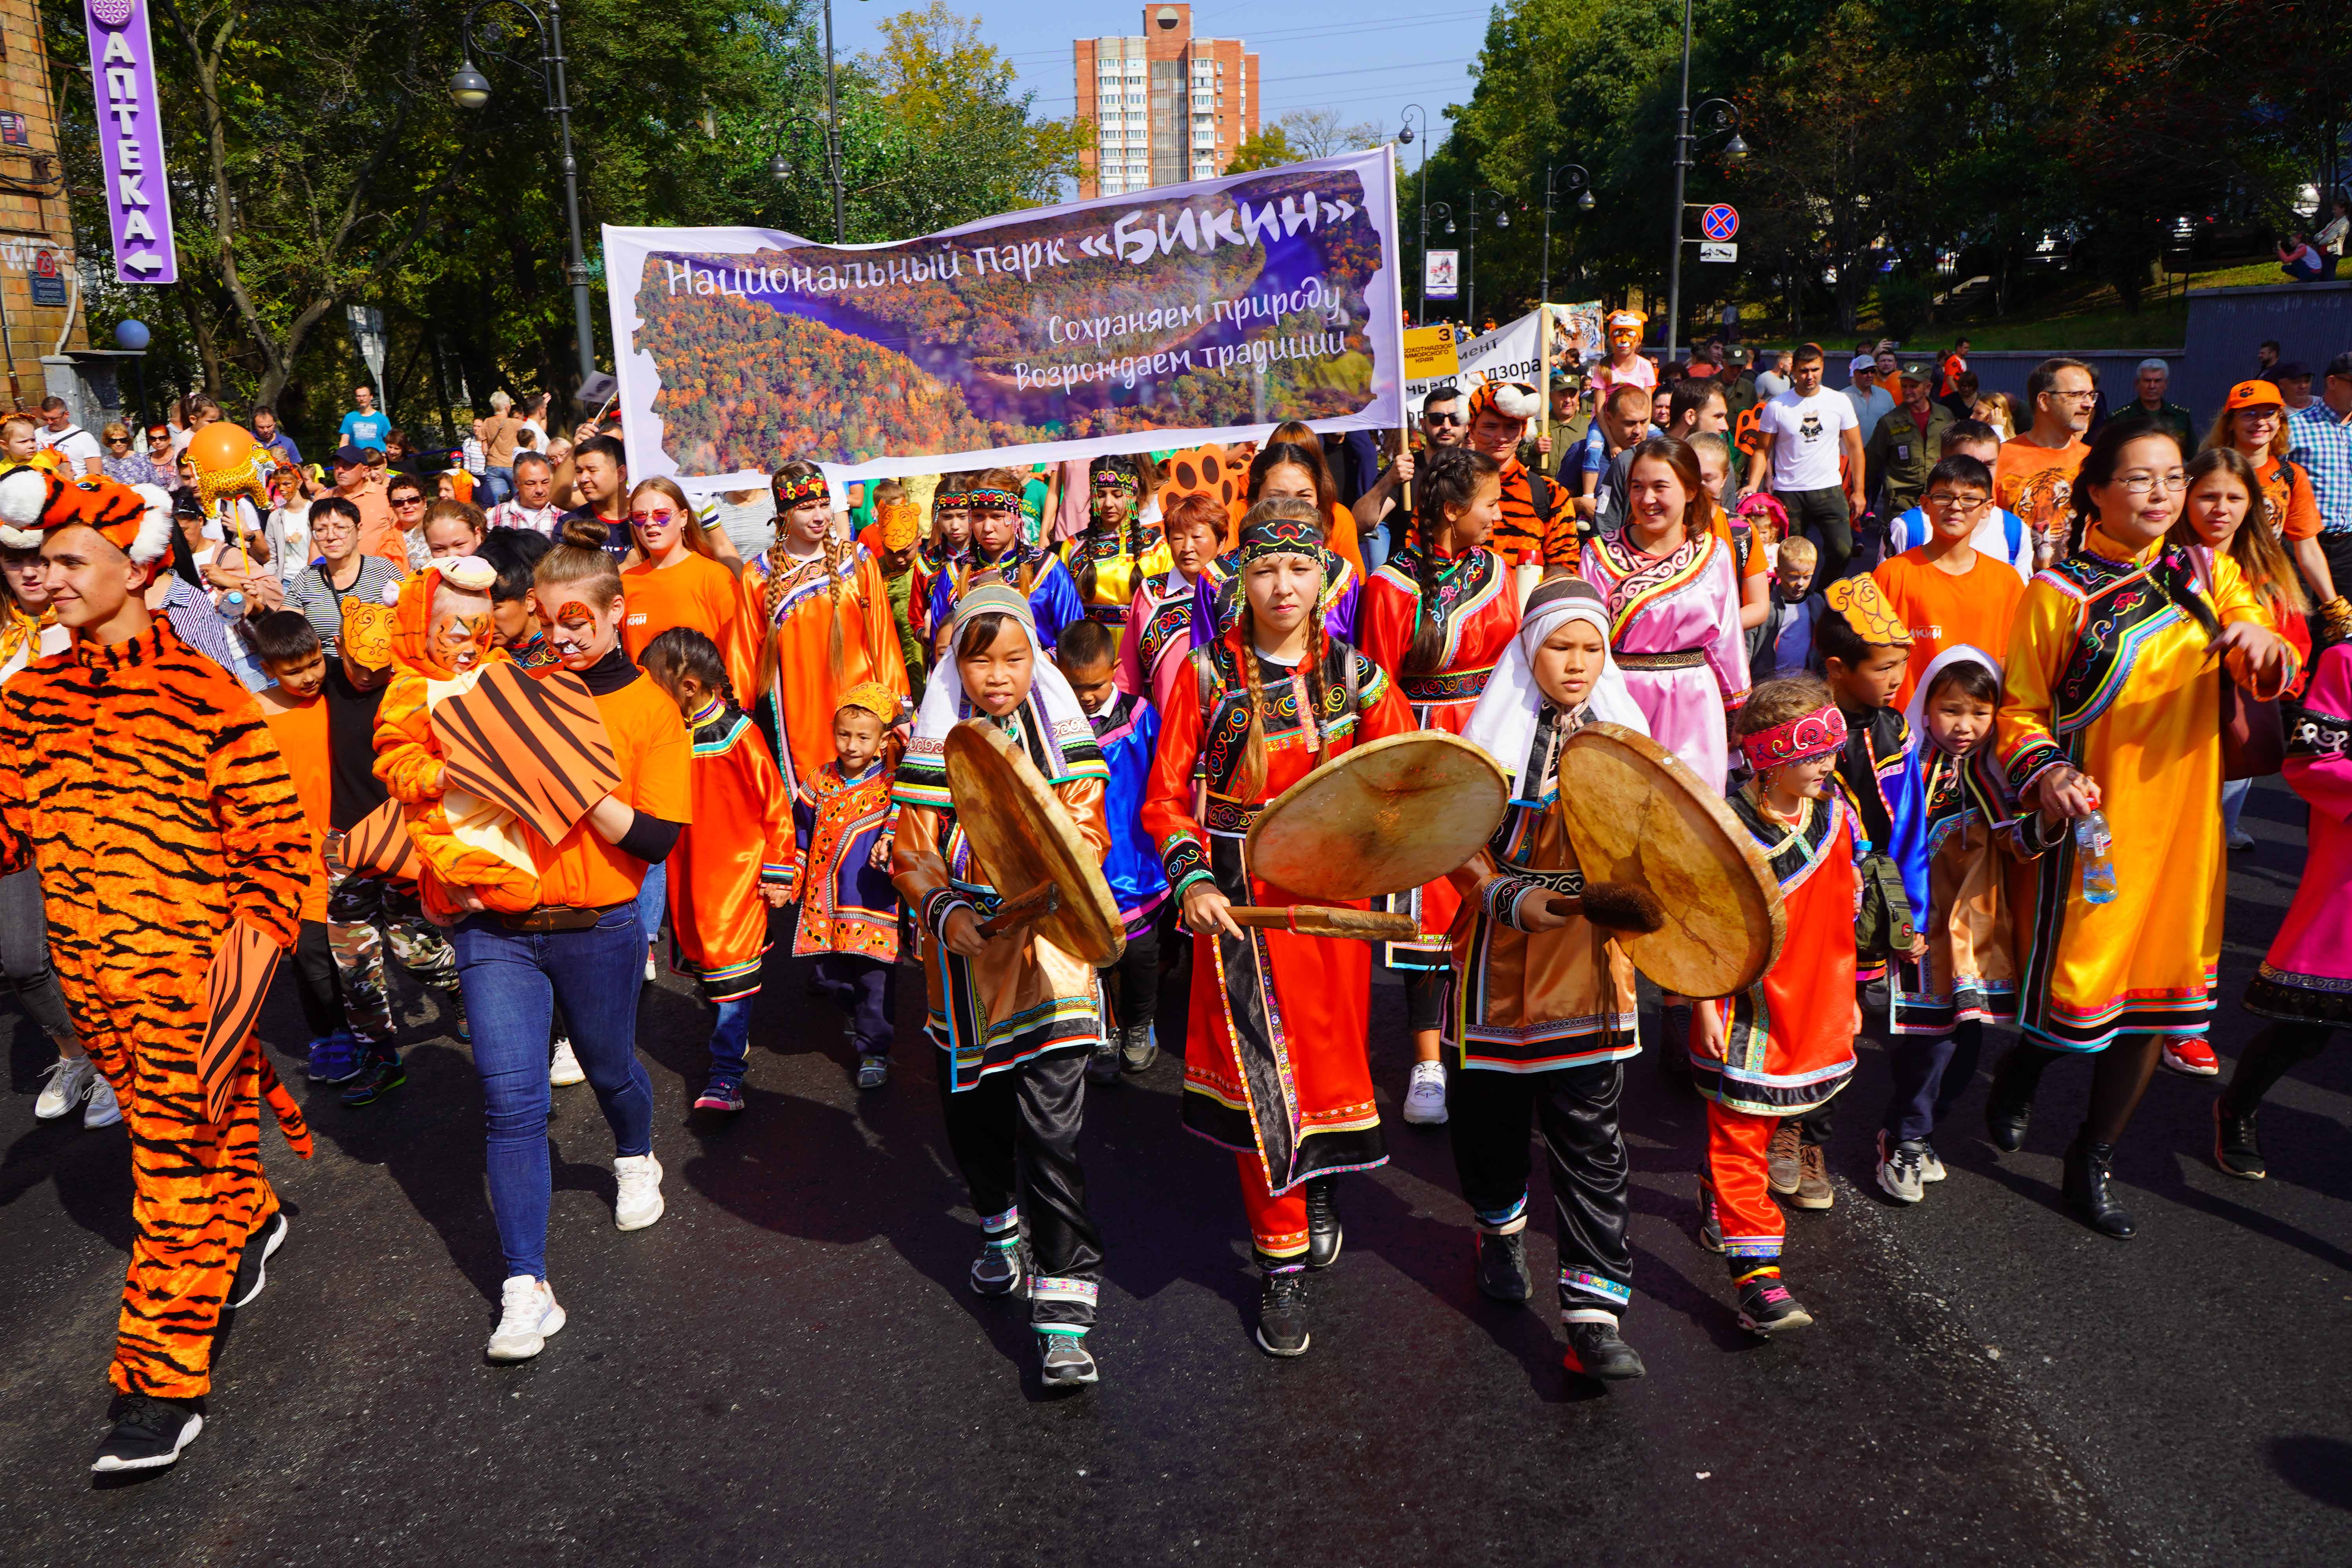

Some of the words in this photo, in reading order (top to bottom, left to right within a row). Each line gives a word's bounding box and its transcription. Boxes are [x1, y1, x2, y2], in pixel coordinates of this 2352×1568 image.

[102, 32, 156, 240] АПТЕКА
[39, 255, 53, 273] 29
[664, 241, 964, 299] Национальный
[973, 237, 1070, 283] парк
[1048, 303, 1203, 348] Сохраняем
[1211, 276, 1341, 331] природу
[1439, 328, 1450, 341] 3
[1013, 352, 1192, 395] Возрождаем
[1200, 330, 1348, 377] традиции
